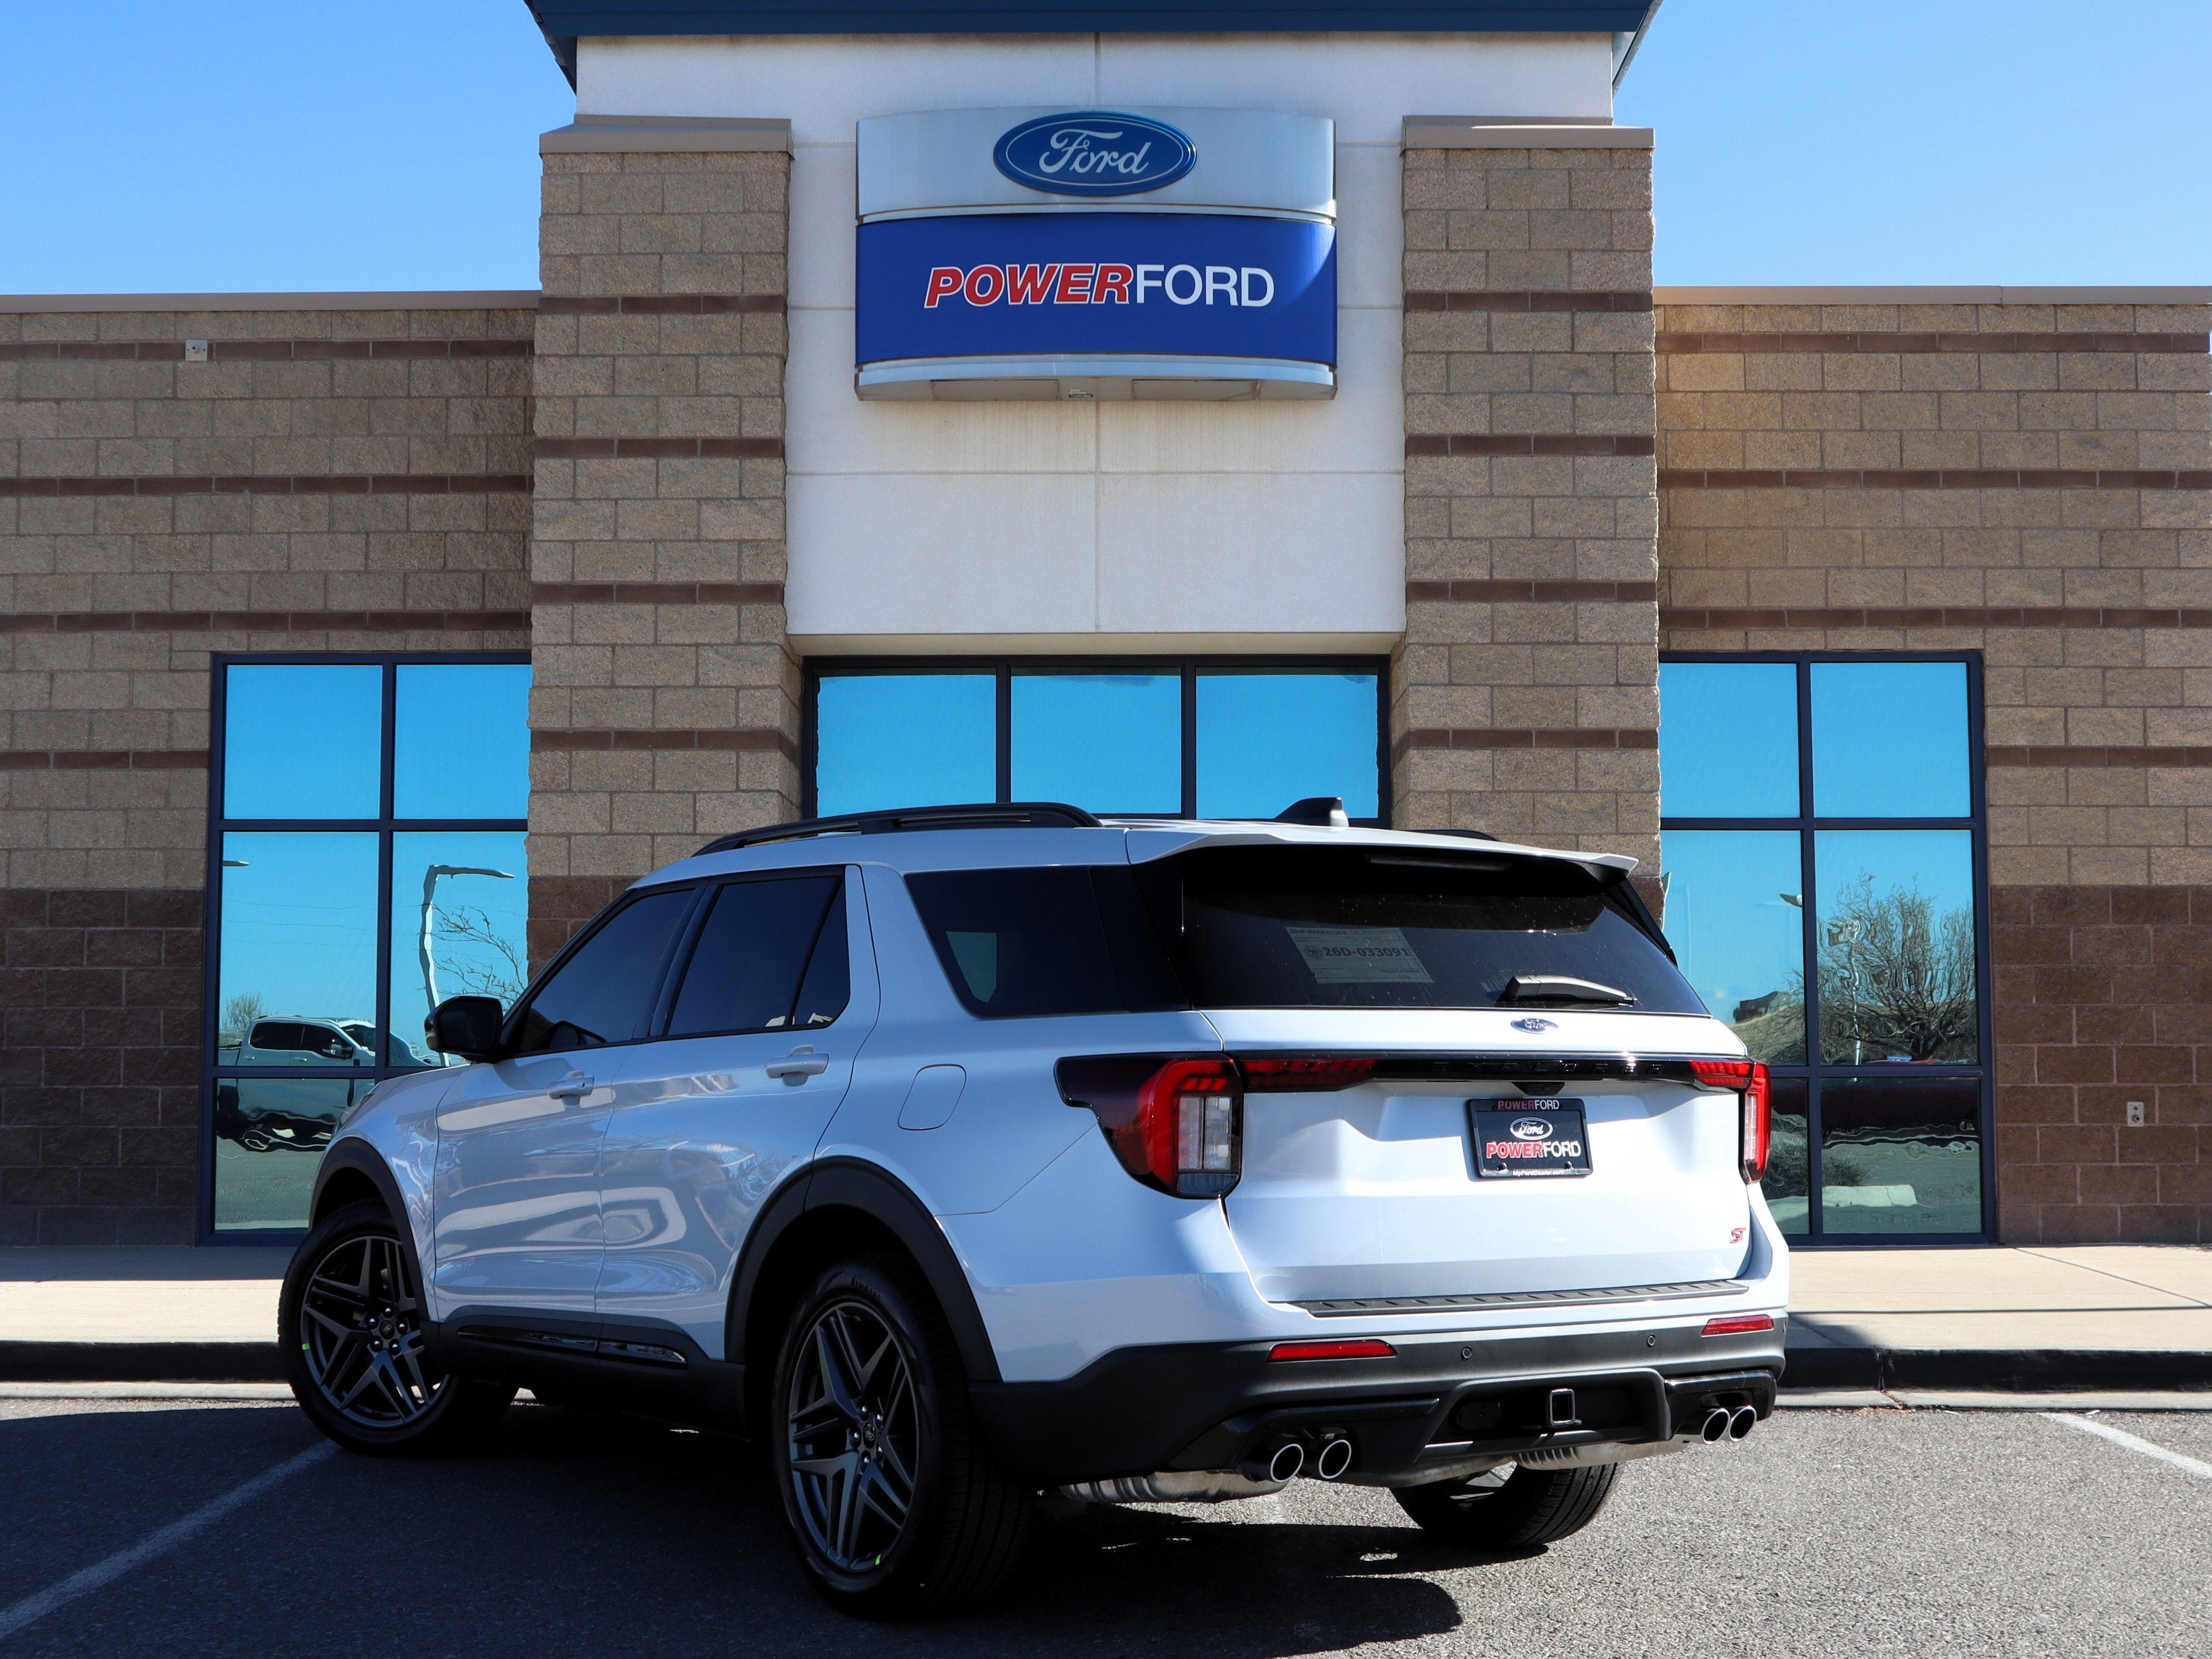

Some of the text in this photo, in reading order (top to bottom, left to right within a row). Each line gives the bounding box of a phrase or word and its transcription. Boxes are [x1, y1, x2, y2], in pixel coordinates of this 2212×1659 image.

[1039, 128, 1150, 175] Ford
[924, 264, 1275, 309] POWERFORD
[1322, 947, 1412, 957] 26D-033091
[1498, 1100, 1560, 1110] POWERFORD
[1519, 1121, 1544, 1136] Ford
[1486, 1141, 1581, 1159] POWERFORD
[1730, 1228, 1746, 1243] ST
